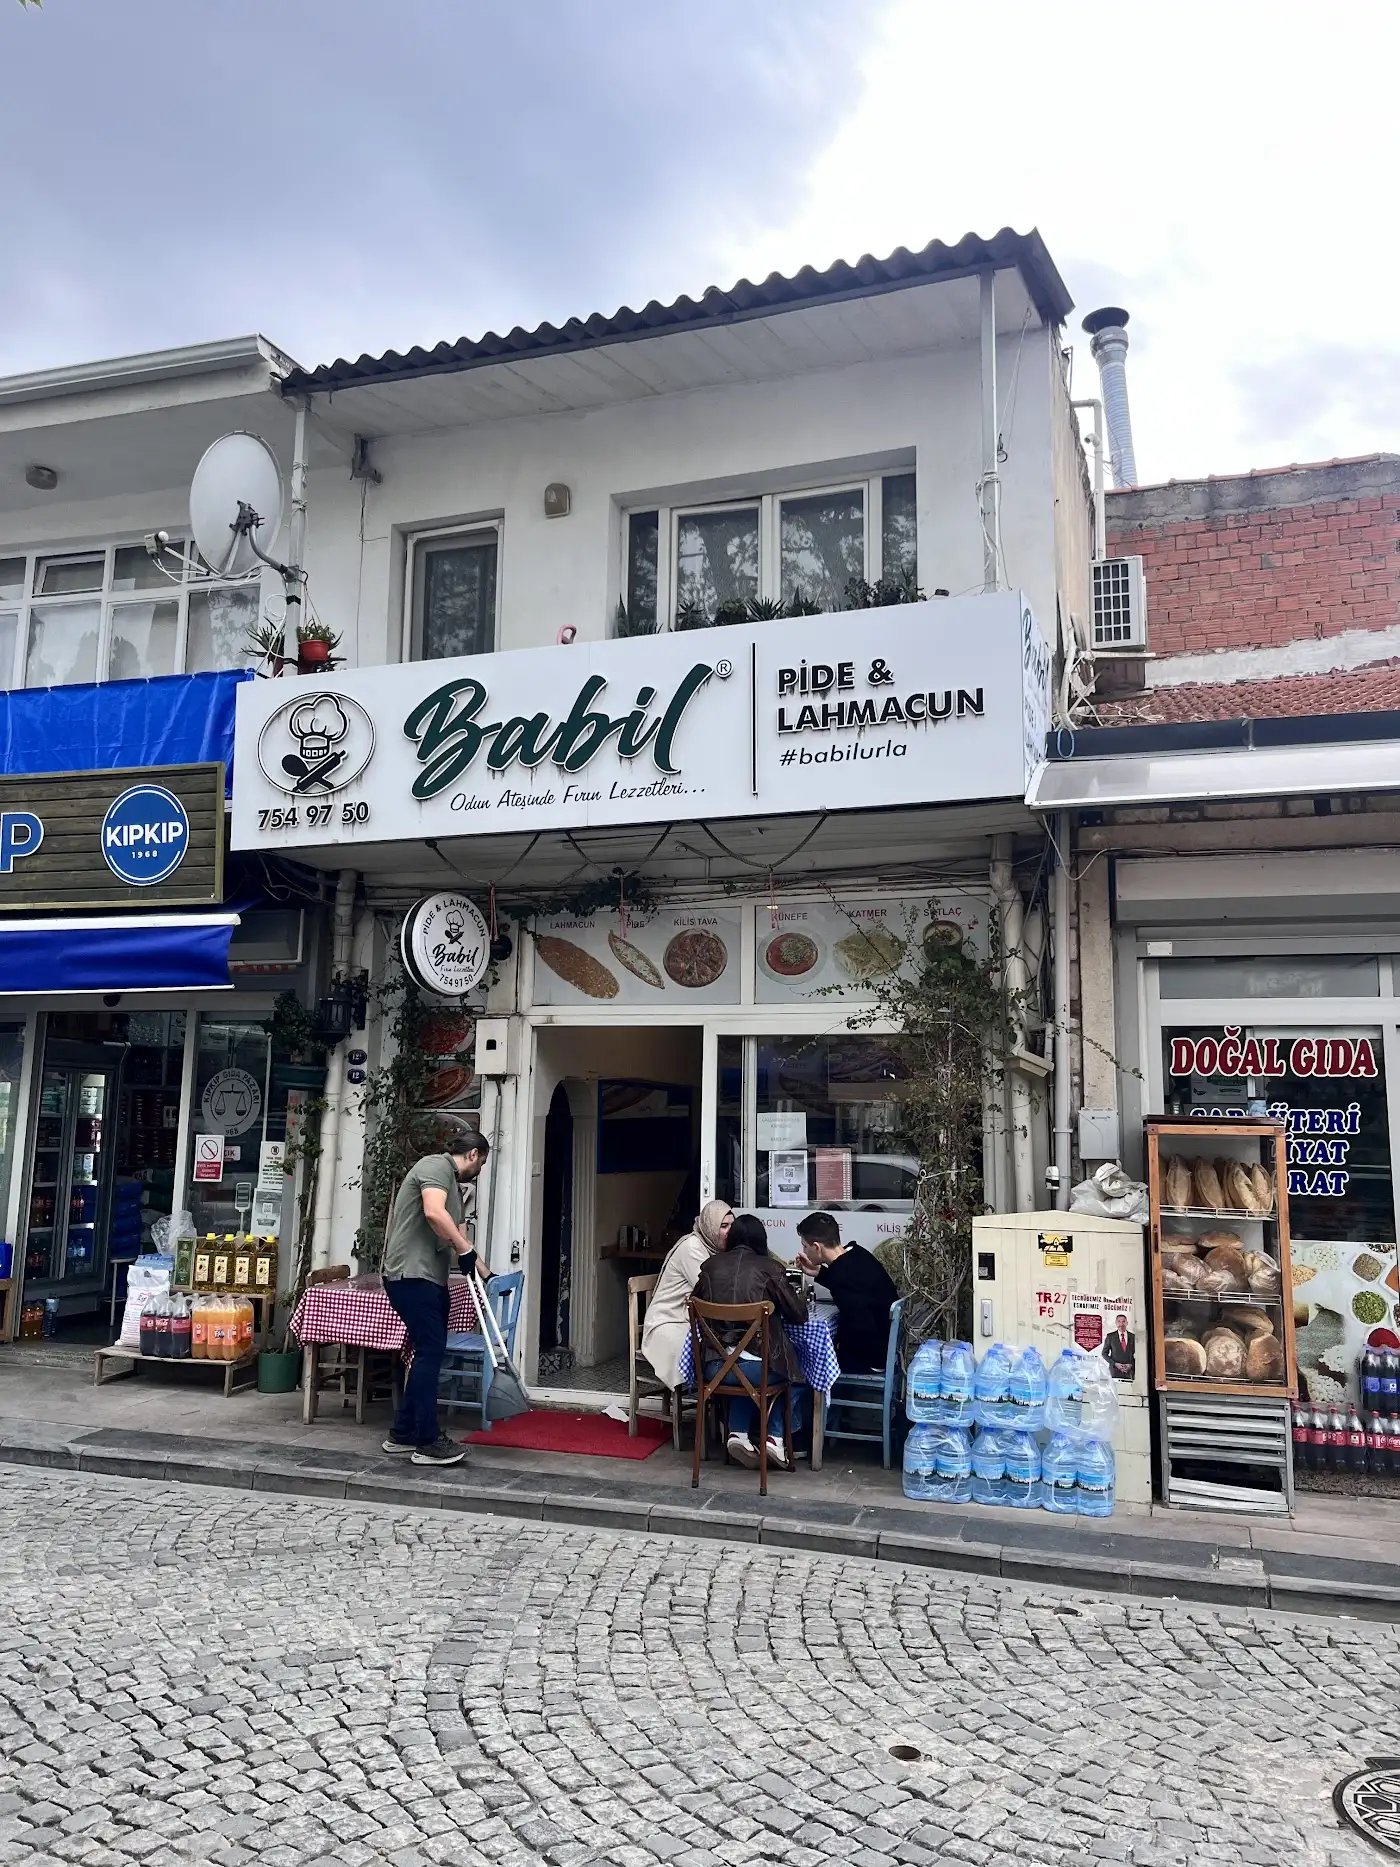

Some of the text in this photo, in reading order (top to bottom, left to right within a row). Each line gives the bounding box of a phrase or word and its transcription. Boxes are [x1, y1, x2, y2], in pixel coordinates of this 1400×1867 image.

[777, 658, 895, 695] PİDE &
[777, 687, 985, 733] LAHMACUN
[403, 663, 714, 800] Babil
[780, 740, 907, 766] #babilurla
[450, 793, 490, 811] Odun
[497, 788, 555, 810] Ateşinde
[563, 785, 601, 803] Fırın
[258, 802, 369, 830] 754 97 50
[106, 821, 183, 847] KIPKIP
[132, 851, 158, 859] 1968
[443, 899, 486, 937] LAHMACUN
[550, 921, 595, 929] LAHMACUN
[697, 918, 718, 926] TAVA
[849, 909, 887, 918] KATMER
[432, 943, 479, 967] Babil
[1170, 1026, 1378, 1078] DOĞAL GIDA
[203, 1070, 260, 1104] KIPKIP GIDA PAZARI
[1287, 1170, 1349, 1196] RAT
